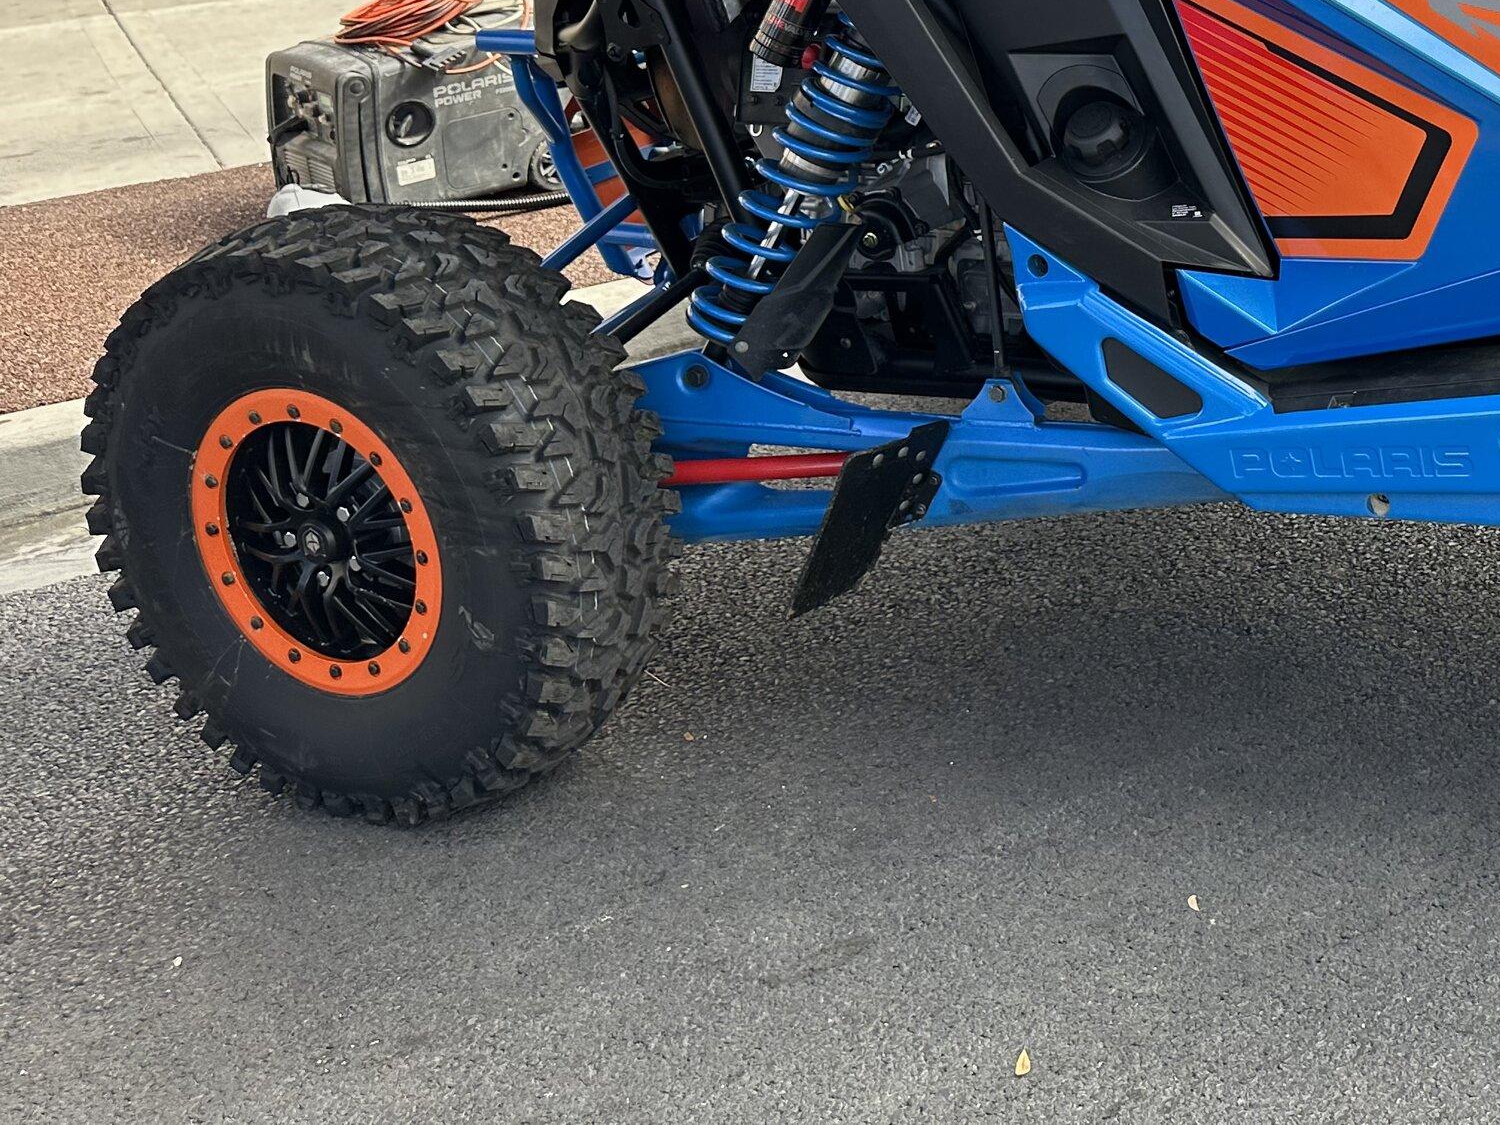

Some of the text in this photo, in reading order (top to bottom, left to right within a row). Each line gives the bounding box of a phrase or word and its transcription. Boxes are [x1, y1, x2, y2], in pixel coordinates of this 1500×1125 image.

[433, 72, 513, 99] POLARIS
[434, 89, 483, 109] POWER
[1228, 444, 1475, 481] POLARIS
